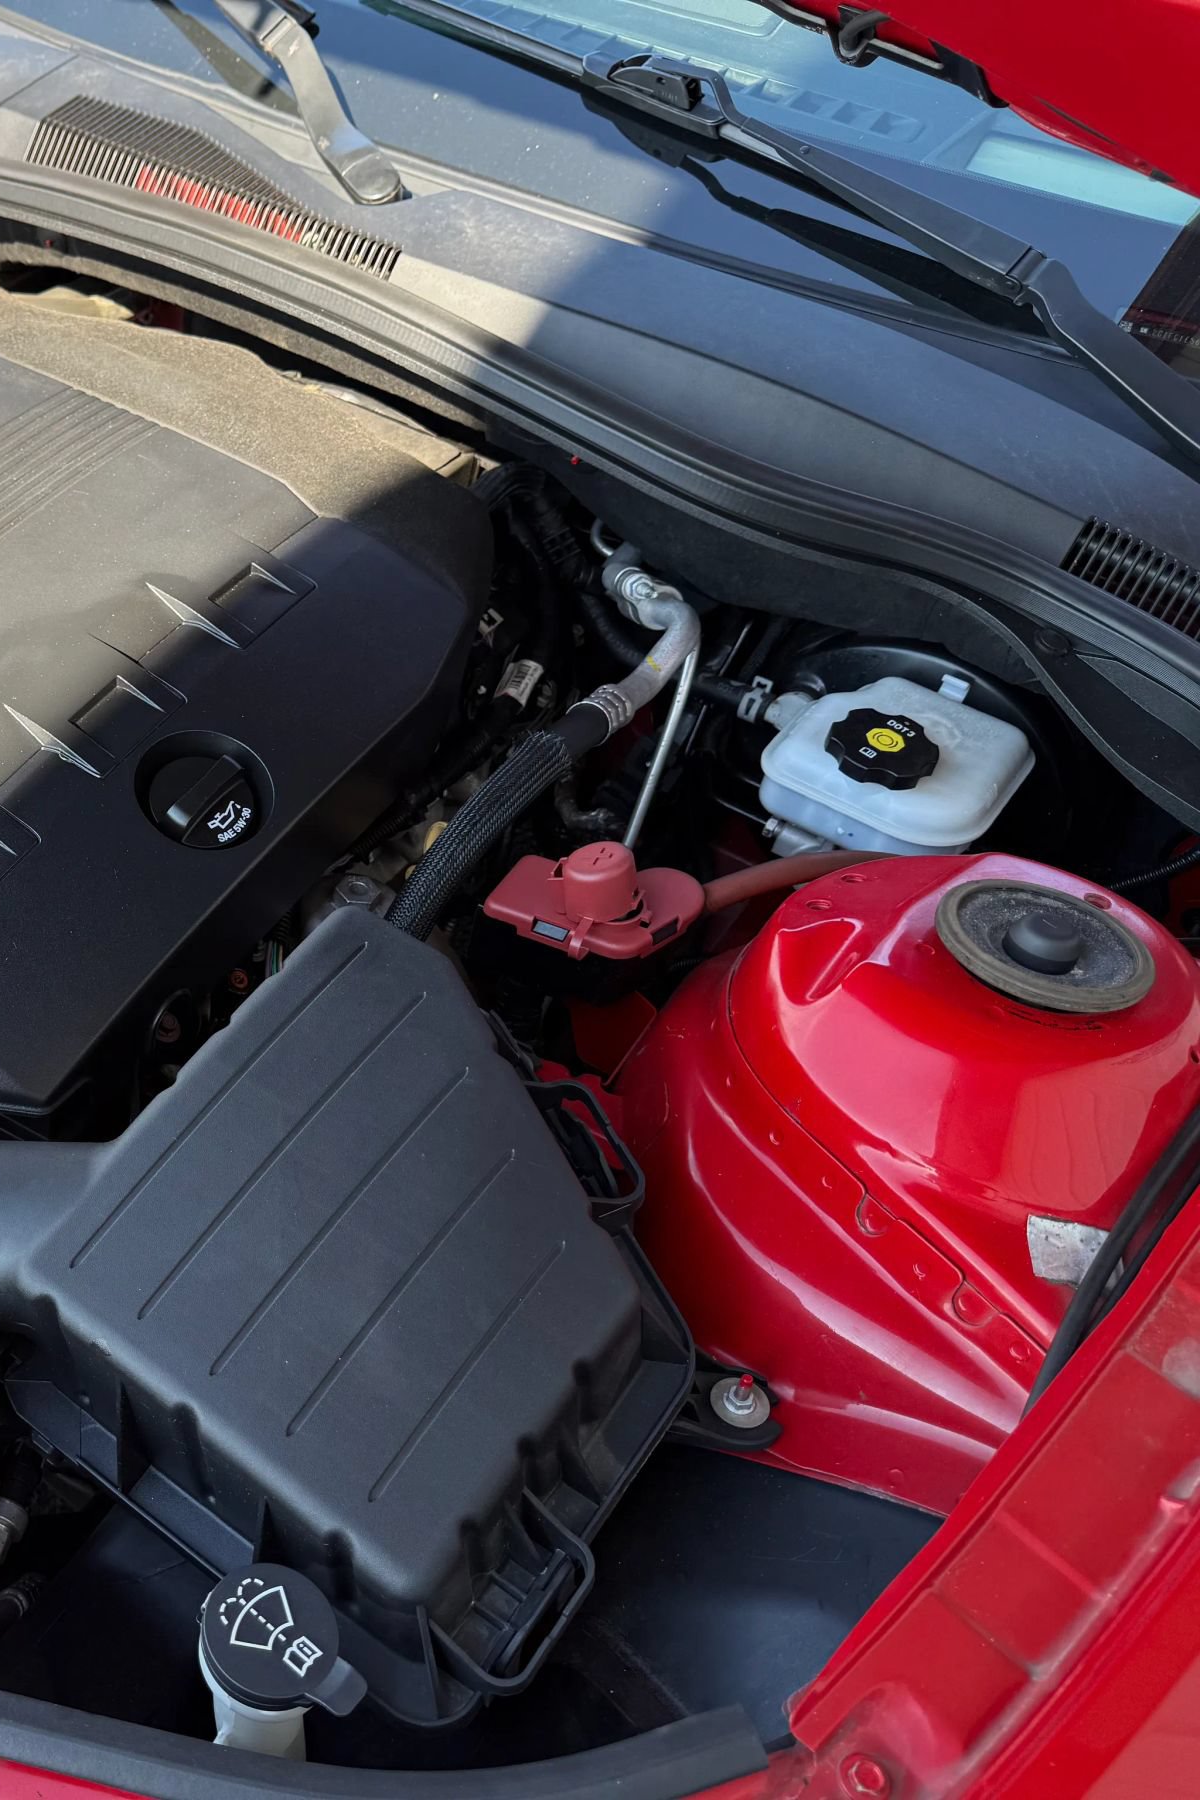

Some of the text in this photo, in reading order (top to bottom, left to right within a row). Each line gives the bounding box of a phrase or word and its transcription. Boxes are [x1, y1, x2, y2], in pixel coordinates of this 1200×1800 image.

[886, 719, 909, 733] DOT
[217, 807, 251, 842] SAE 5W-30
